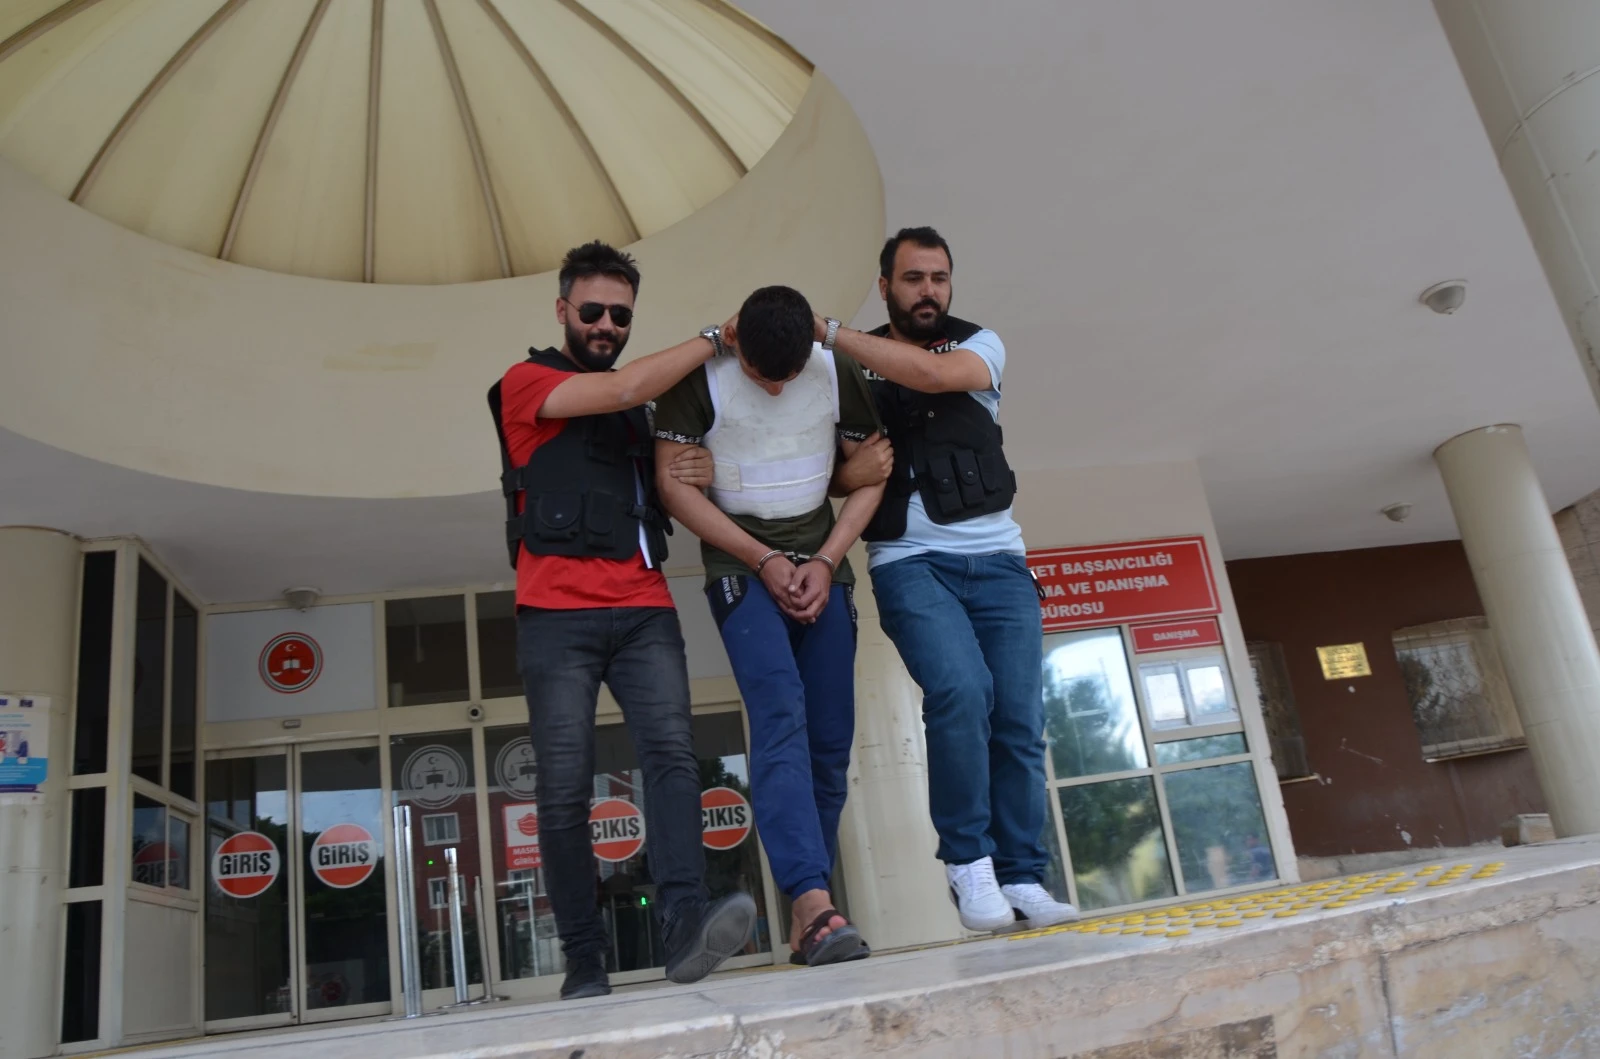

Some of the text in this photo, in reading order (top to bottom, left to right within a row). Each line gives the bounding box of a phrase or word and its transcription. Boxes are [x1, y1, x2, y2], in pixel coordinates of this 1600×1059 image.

[1061, 552, 1174, 576] BAŞSAVCILIĞI
[1068, 581, 1092, 596] VE
[1095, 574, 1169, 592] DANIŞMA
[1152, 629, 1200, 642] DANIŞMA
[589, 816, 640, 843] ÇIKIŞ
